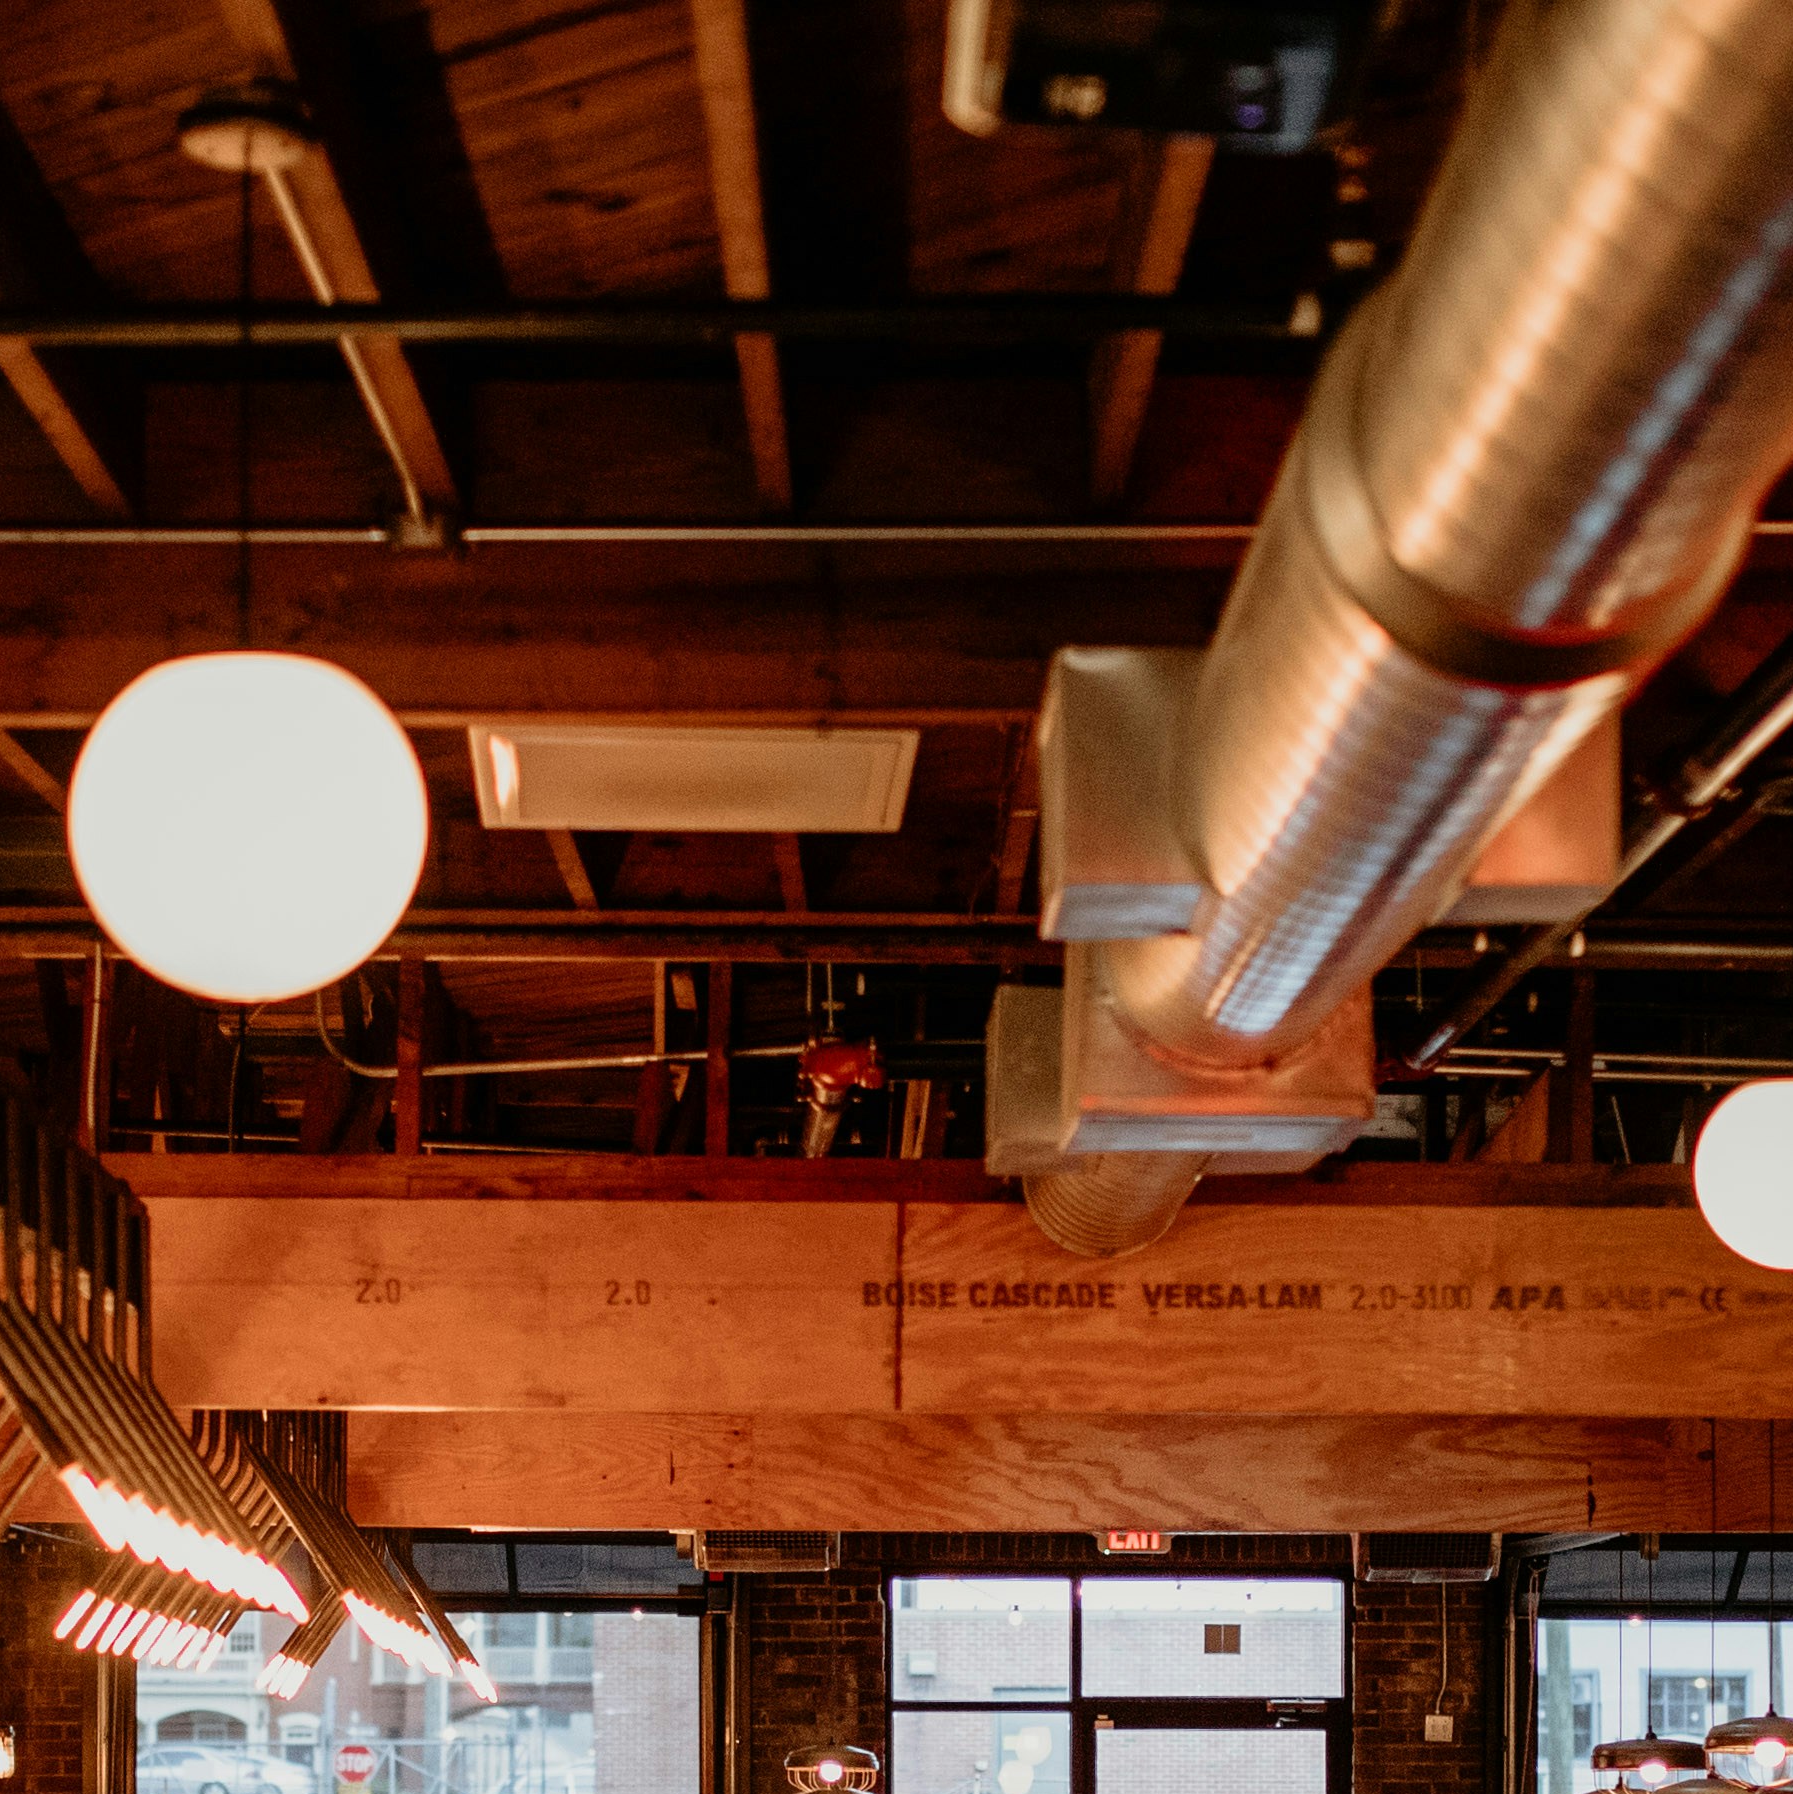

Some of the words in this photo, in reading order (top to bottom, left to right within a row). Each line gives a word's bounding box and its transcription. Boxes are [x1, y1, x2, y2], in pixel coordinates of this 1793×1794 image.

[355, 1278, 402, 1304] 2.0
[605, 1279, 652, 1306] 2.0
[862, 1281, 958, 1308] BOISE
[969, 1282, 1117, 1310] CASCADE
[1141, 1283, 1323, 1311] VERSA-LAM
[1349, 1284, 1473, 1311] 2.0-3100
[1488, 1285, 1566, 1312] APA
[335, 1753, 374, 1773] STOP
